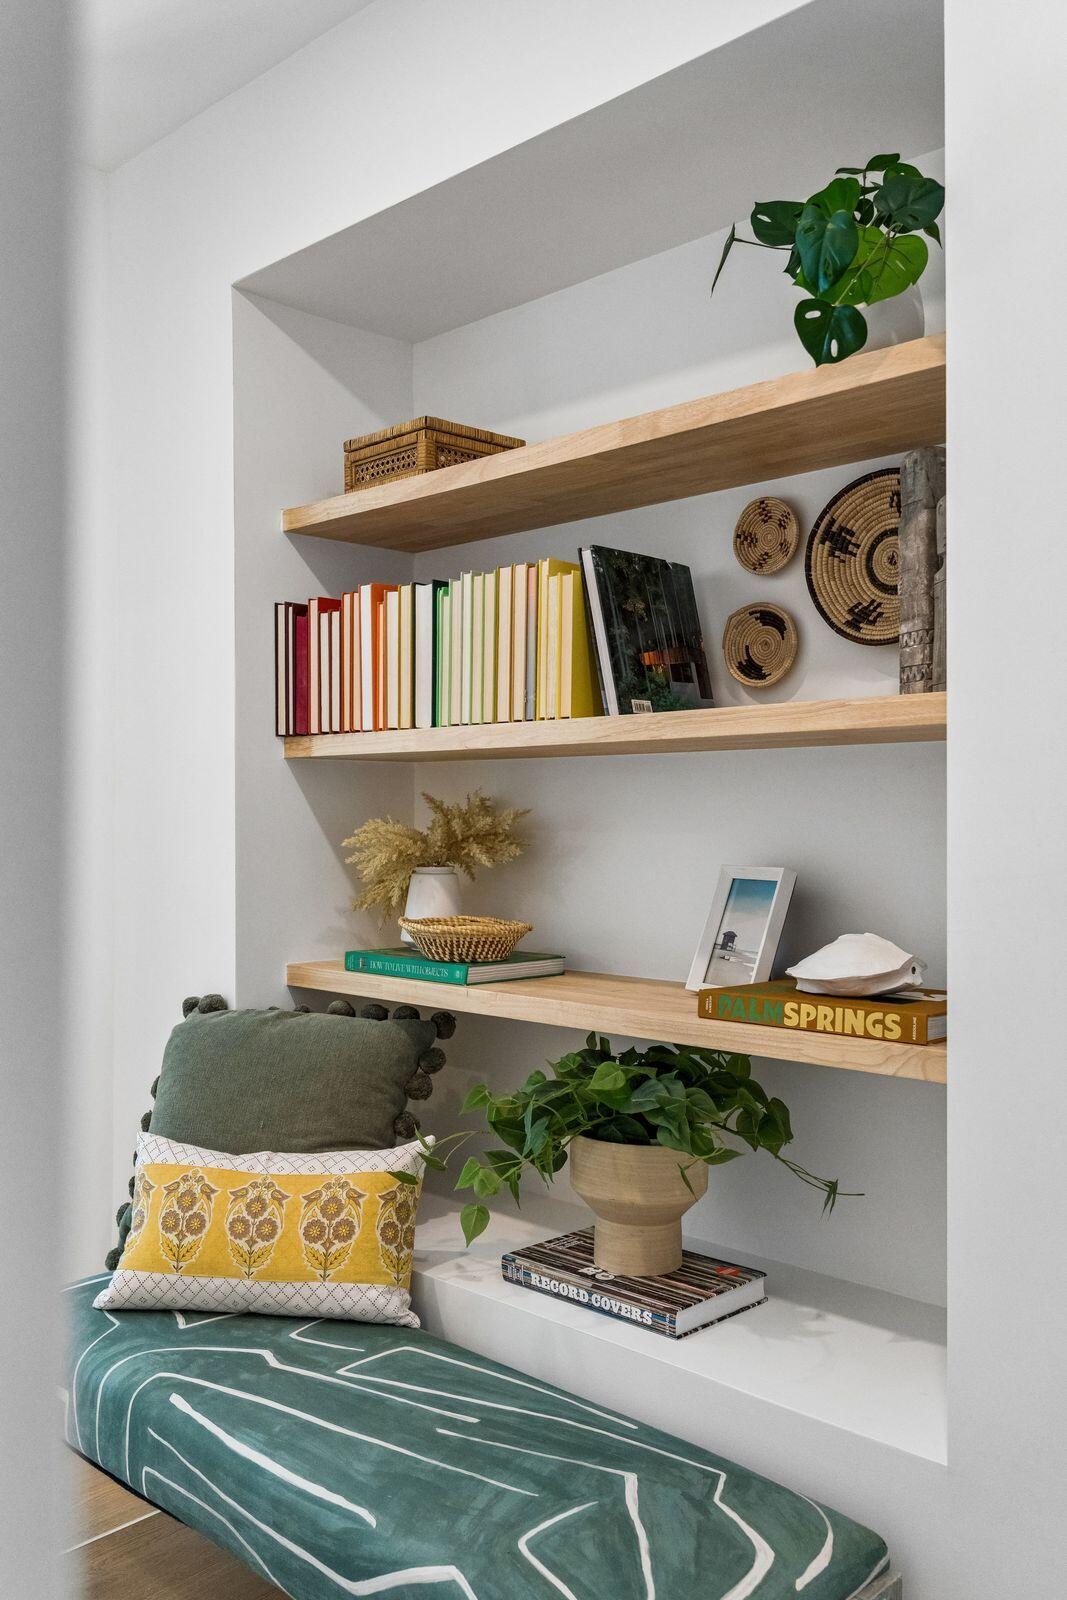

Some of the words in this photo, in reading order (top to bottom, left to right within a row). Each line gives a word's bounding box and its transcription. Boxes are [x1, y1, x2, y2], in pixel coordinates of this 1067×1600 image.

[370, 960, 383, 969] HOW
[393, 962, 405, 972] LIVE
[405, 964, 422, 975] WITH
[422, 966, 449, 977] OBJECTS
[717, 994, 784, 1025] PALM
[783, 1001, 902, 1039] SPRINGS
[530, 1273, 589, 1304] RECORD
[591, 1294, 653, 1325] COVERS
